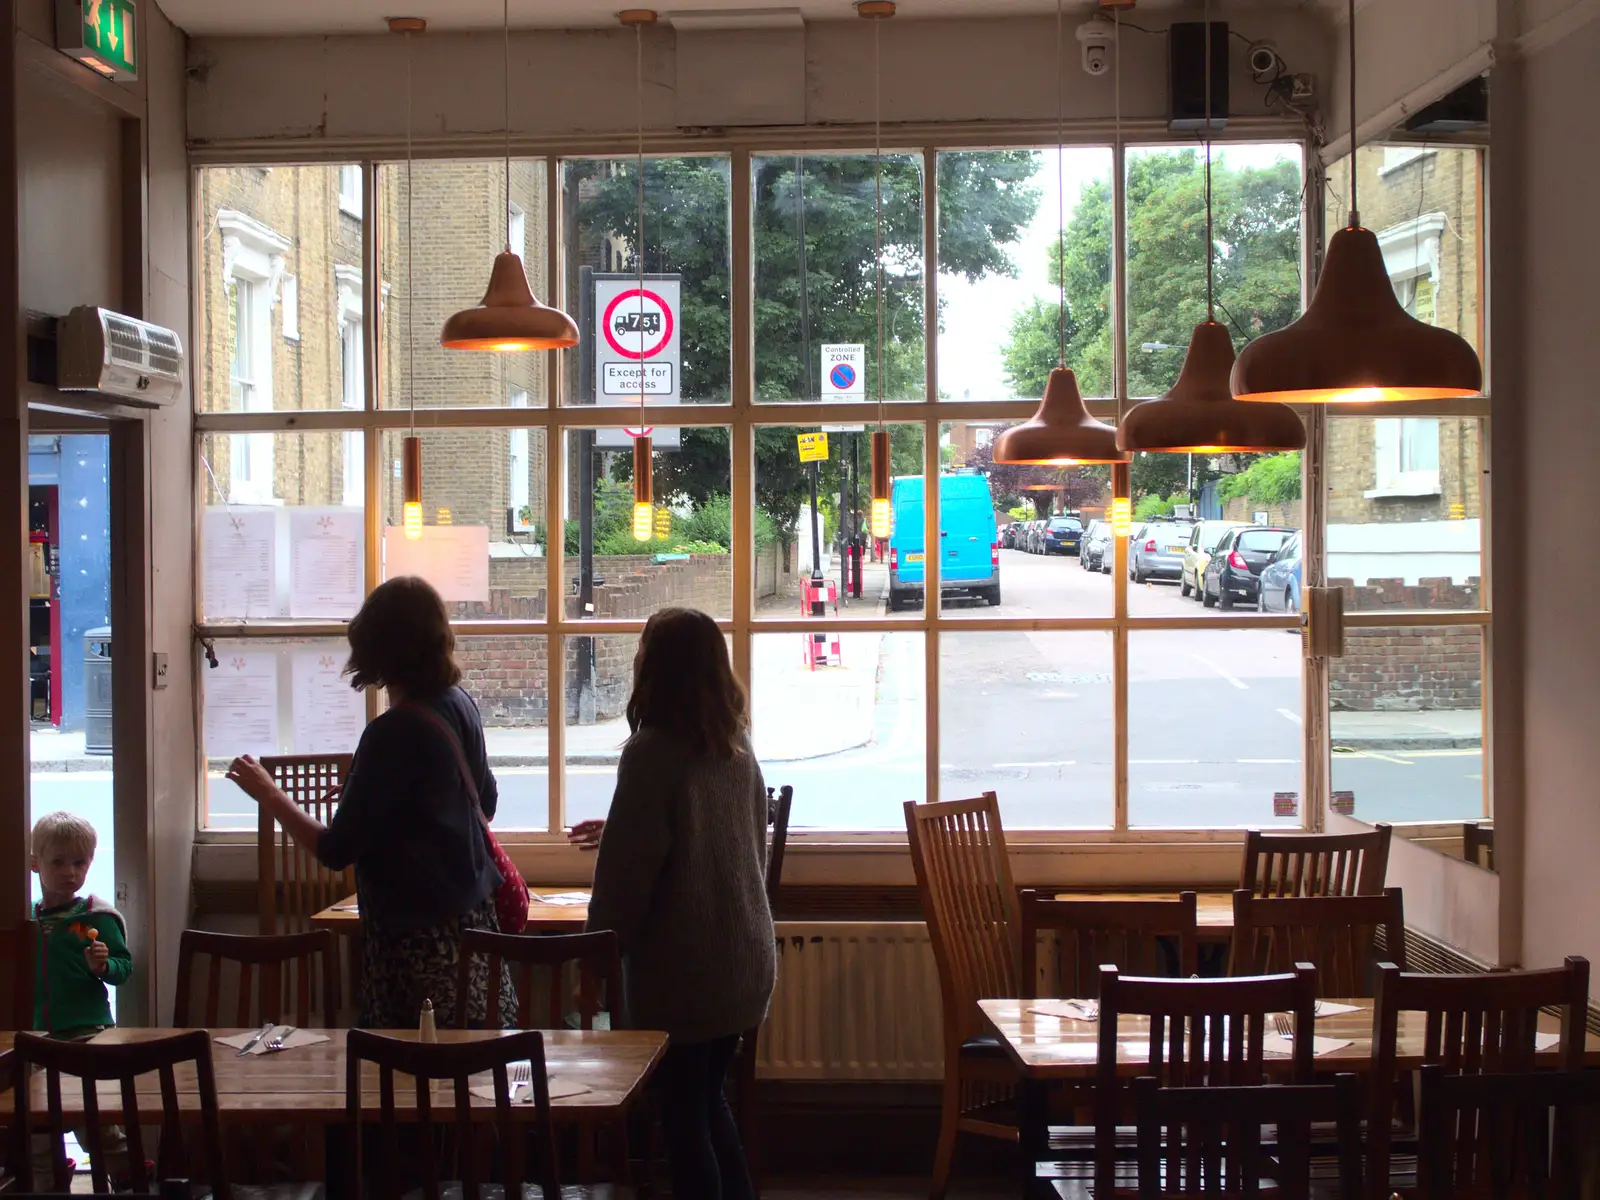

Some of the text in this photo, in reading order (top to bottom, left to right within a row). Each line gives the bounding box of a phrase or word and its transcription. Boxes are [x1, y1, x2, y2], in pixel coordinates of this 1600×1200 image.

[609, 368, 666, 378] Except for
[620, 381, 656, 389] access
